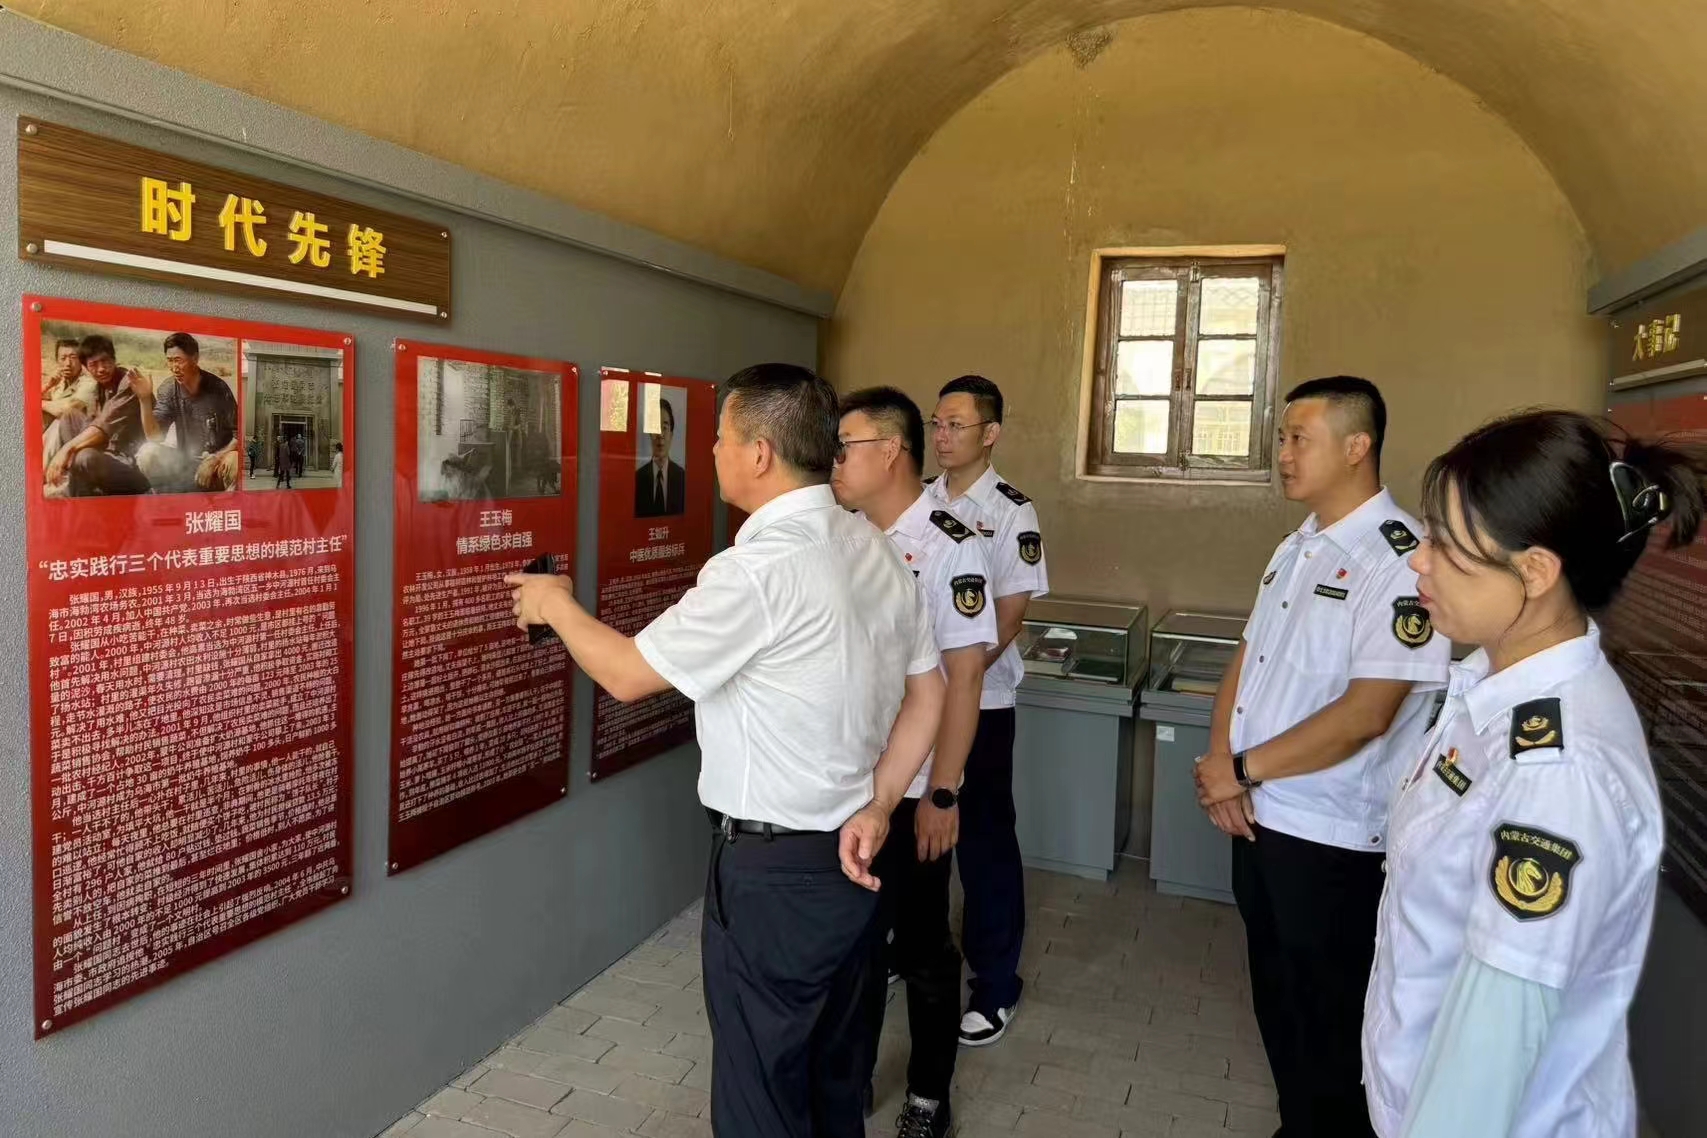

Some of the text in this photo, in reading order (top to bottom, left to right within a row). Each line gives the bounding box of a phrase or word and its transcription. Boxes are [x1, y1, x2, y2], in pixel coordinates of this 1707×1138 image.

[140, 177, 387, 279] 时代先锋
[185, 509, 241, 535] 张耀国
[480, 509, 512, 527] 王玉梅
[456, 531, 533, 555] 情系绿色求自强
[1500, 829, 1573, 860] 内蒙古交通集团
